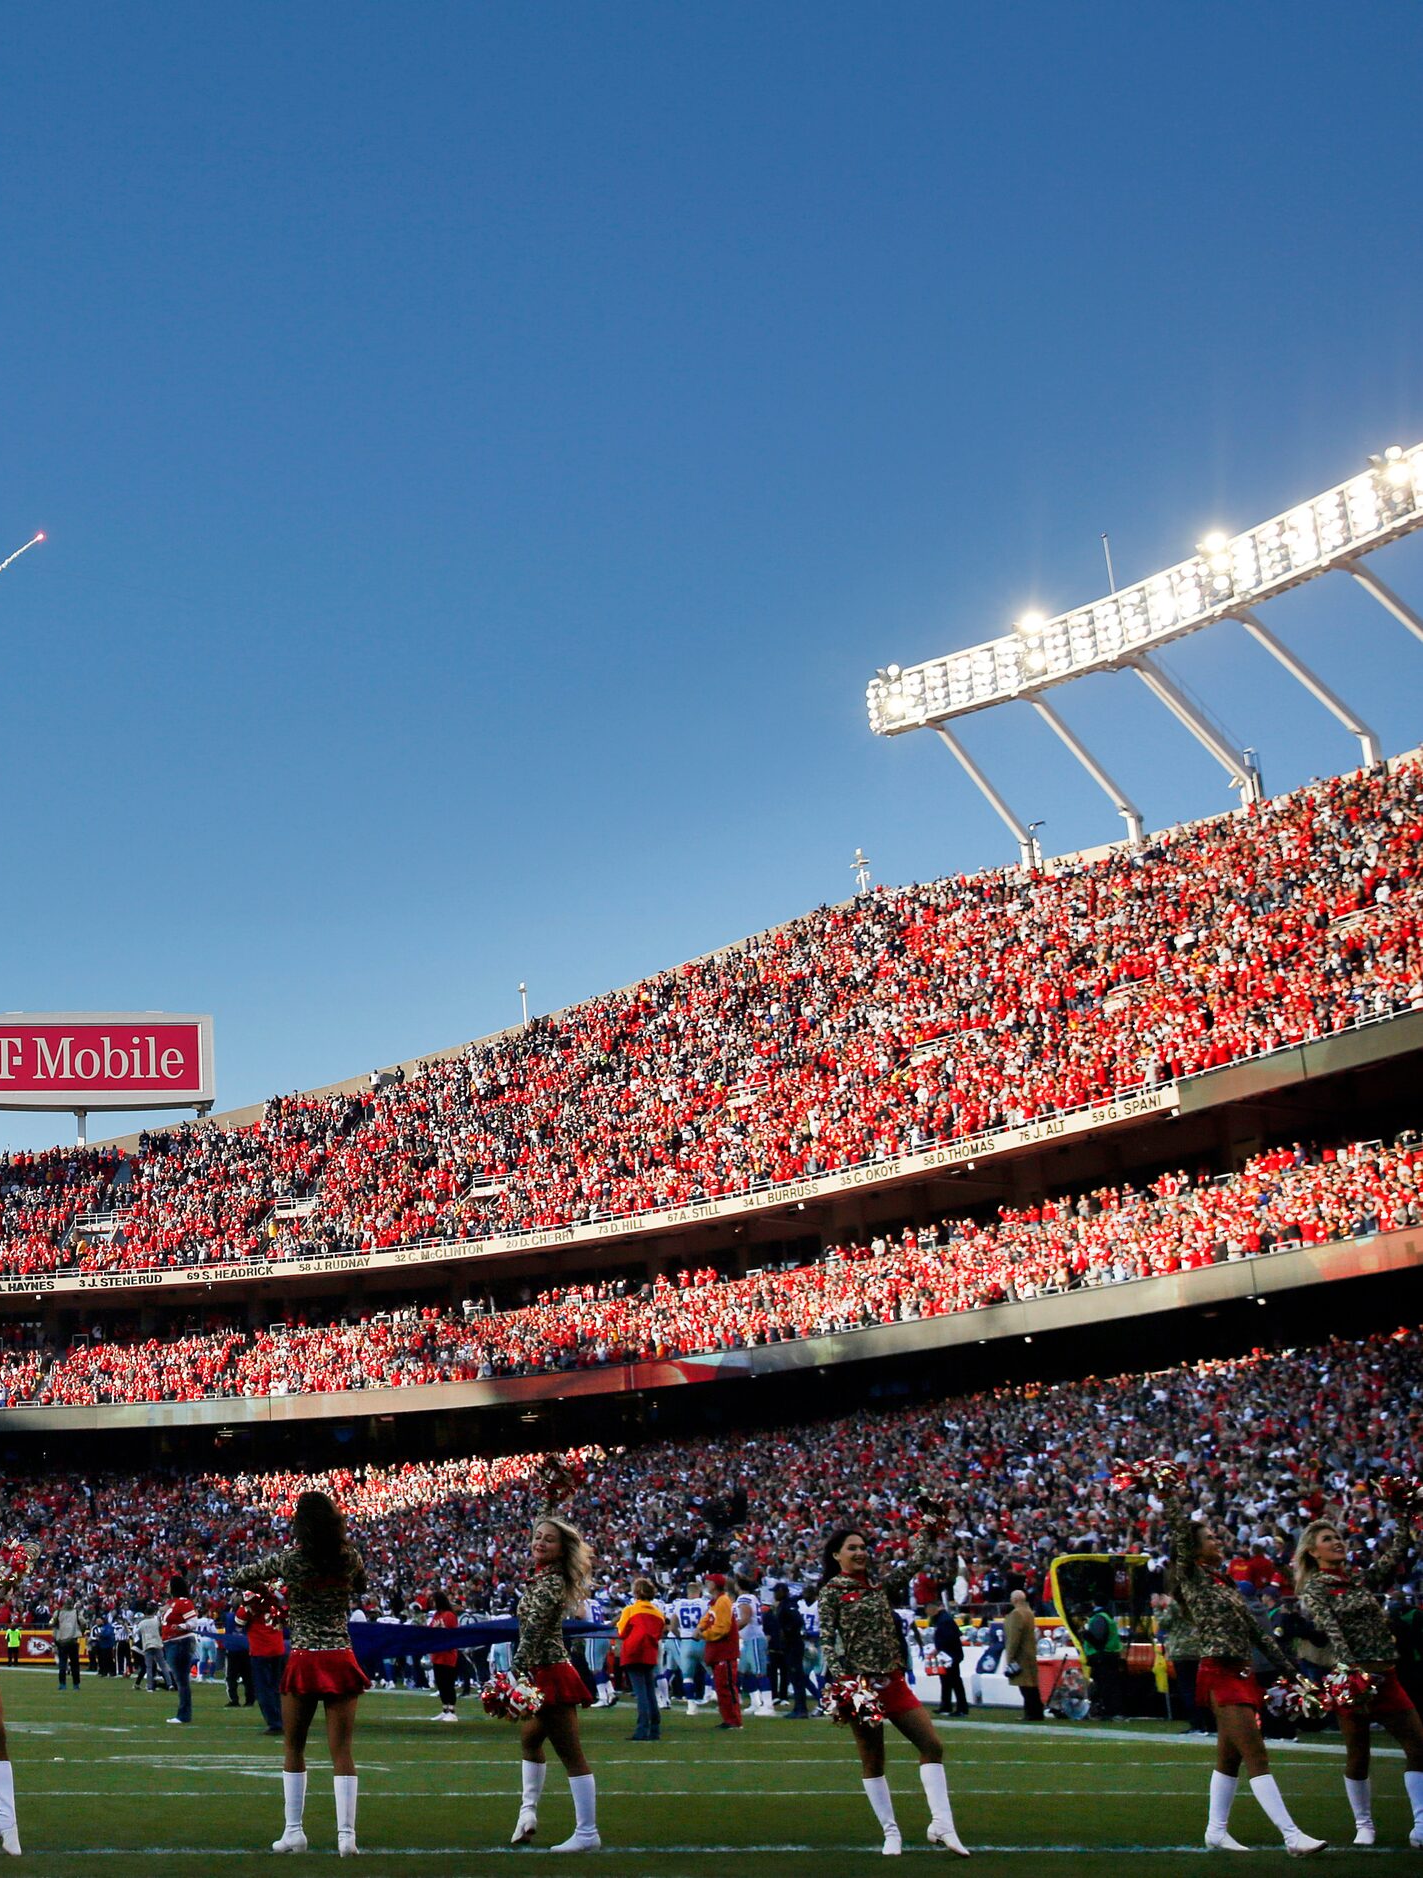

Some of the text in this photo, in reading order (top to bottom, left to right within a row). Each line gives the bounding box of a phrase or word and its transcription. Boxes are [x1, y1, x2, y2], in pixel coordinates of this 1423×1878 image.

[32, 1036, 185, 1080] Mobile
[1092, 1094, 1162, 1123] 59 G. SPANI
[1019, 1120, 1065, 1142] 76 J. ALT
[938, 1152, 948, 1163] D.
[948, 1139, 995, 1161] THOMAS
[866, 1163, 901, 1181] OKOYE
[743, 1184, 819, 1208] 34 L. BURRUSS
[667, 1204, 721, 1223] 67 A. STILL
[611, 1224, 621, 1233] D.
[622, 1218, 646, 1232] HILL
[520, 1238, 530, 1248] D.
[531, 1230, 576, 1247] CHERRY
[421, 1244, 484, 1261] McCLINTON
[201, 1271, 214, 1281] S.
[216, 1266, 274, 1280] HEADRICK
[314, 1262, 324, 1272] J.
[325, 1257, 370, 1271] RUDNAY
[8, 1281, 55, 1292] HAYNES
[79, 1274, 163, 1288] 3 J. STENERUD
[680, 1606, 702, 1629] 63
